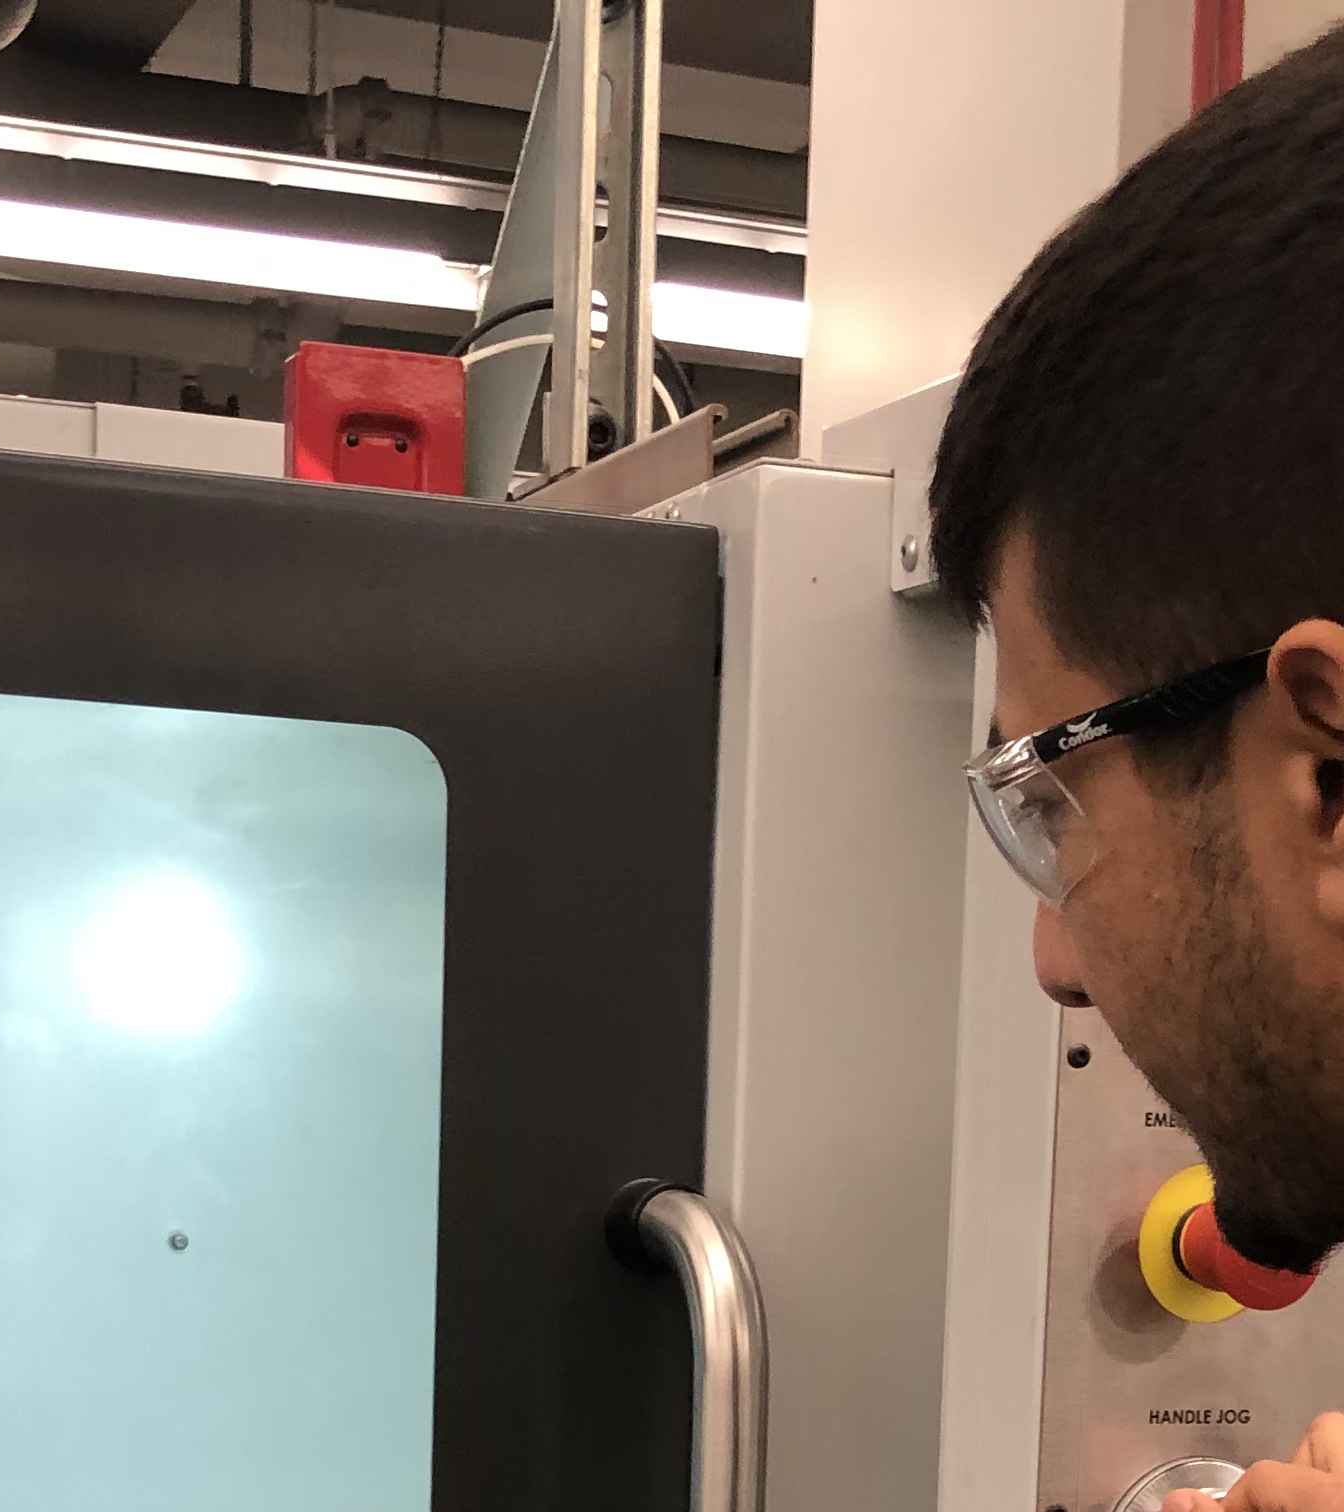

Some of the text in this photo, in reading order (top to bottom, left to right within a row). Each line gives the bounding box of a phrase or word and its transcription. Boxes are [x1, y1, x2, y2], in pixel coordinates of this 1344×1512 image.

[1058, 723, 1108, 751] Condor
[1149, 1408, 1251, 1424] HANDLE JOG
